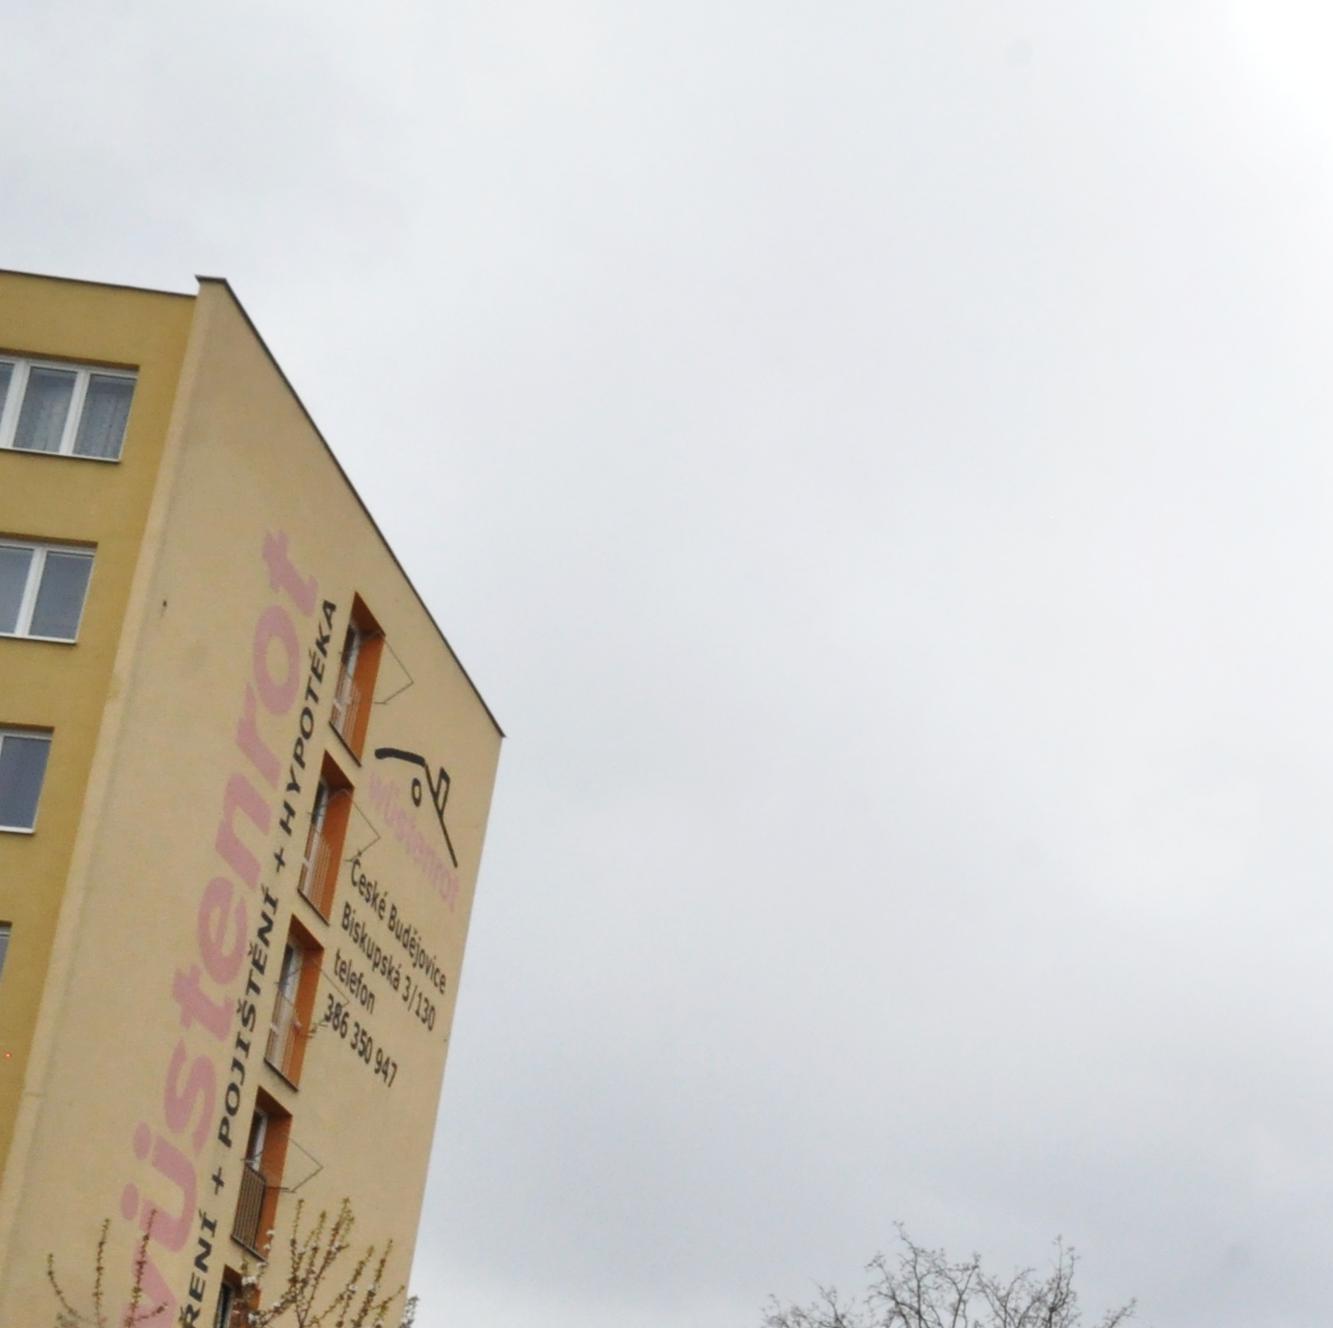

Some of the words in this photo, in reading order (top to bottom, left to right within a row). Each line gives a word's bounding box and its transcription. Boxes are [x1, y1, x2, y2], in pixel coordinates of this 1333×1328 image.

[217, 882, 280, 1148] POJIŠTĚNÍ
[279, 599, 337, 838] HYPOTÉKA
[350, 848, 387, 921] České
[388, 909, 447, 995] Budějovice
[334, 947, 376, 1016] telefon
[341, 902, 402, 991] Biskupská
[401, 975, 436, 1032] 3/130
[323, 992, 348, 1039] 386
[350, 1021, 373, 1065] 350
[374, 1054, 398, 1089] 947
